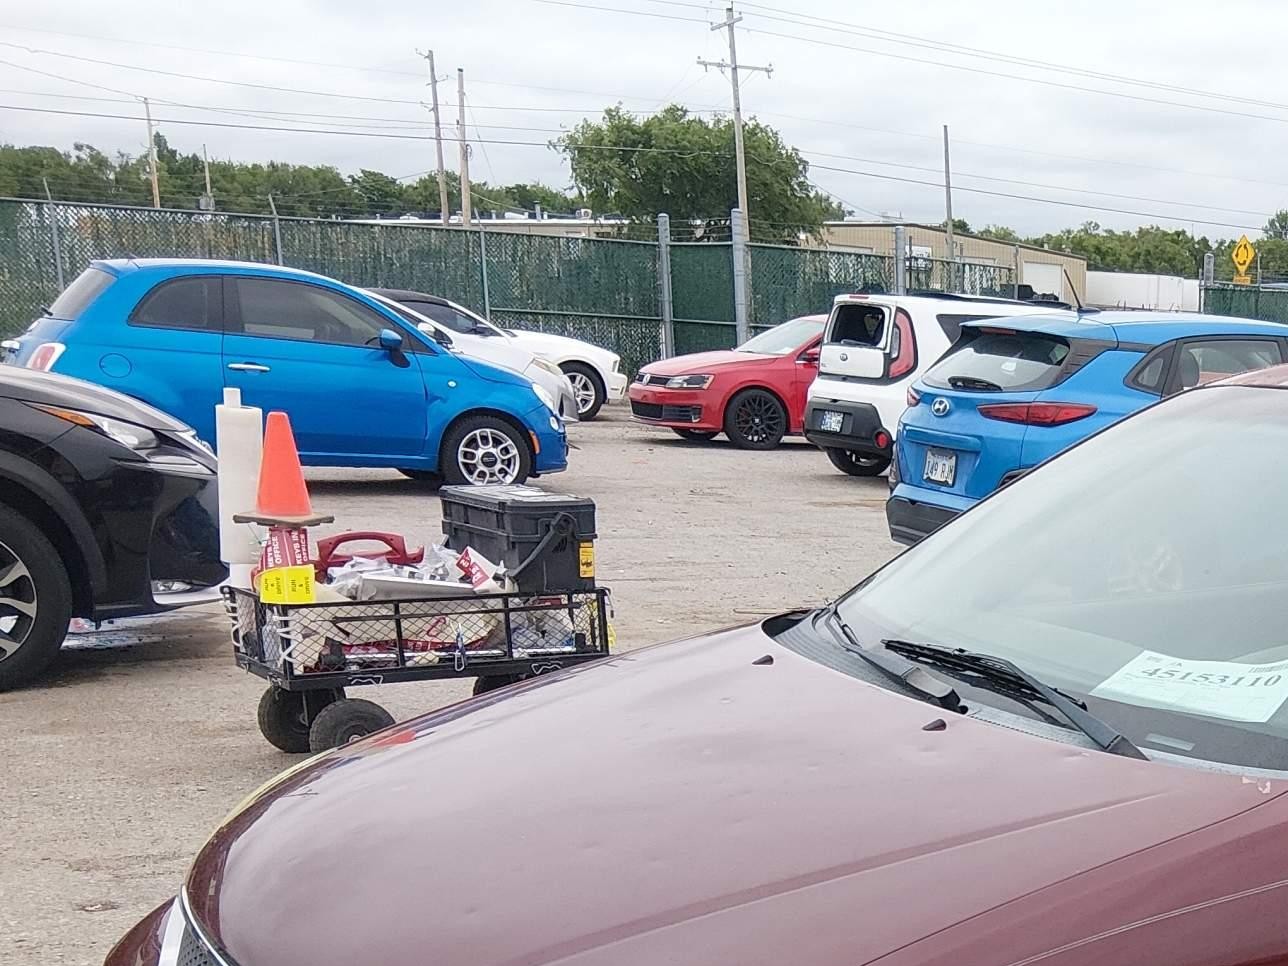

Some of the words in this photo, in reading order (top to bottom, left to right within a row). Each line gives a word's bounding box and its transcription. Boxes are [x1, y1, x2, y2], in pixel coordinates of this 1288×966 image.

[291, 531, 299, 541] IN
[272, 536, 282, 564] OFFICE
[293, 543, 303, 565] KEYS
[1141, 667, 1282, 688] 45153110
